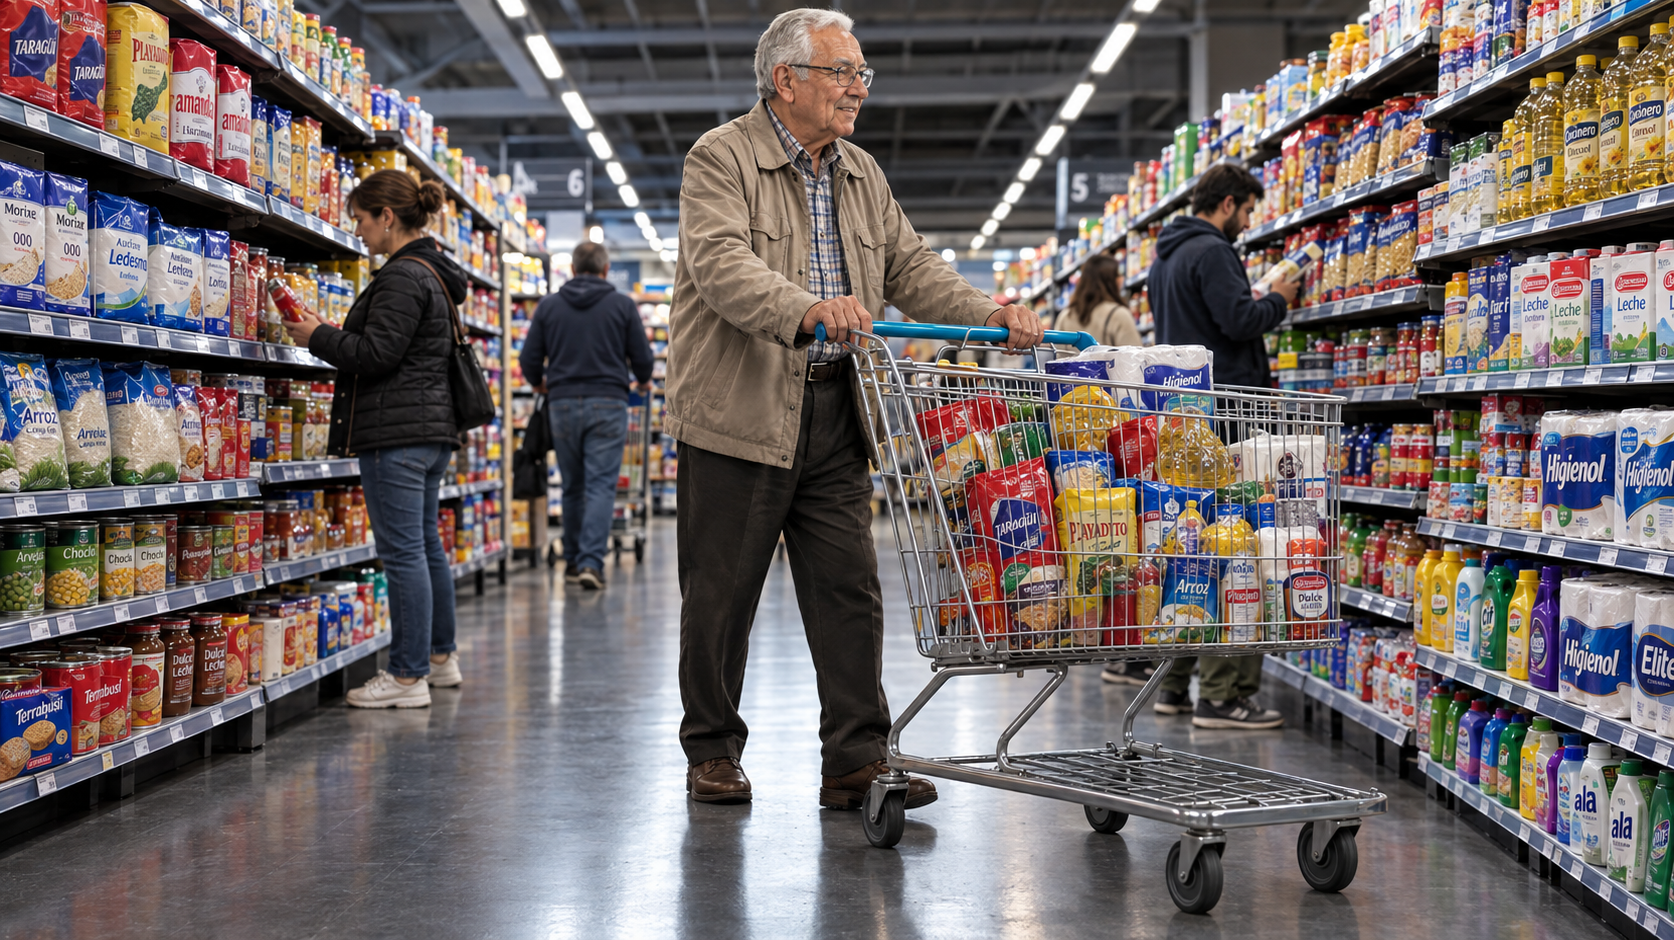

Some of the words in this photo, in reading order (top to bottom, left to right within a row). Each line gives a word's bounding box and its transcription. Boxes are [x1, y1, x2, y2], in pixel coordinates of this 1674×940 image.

[15, 37, 57, 55] TARAGÜI
[567, 168, 585, 197] 6
[1070, 172, 1089, 203] 5
[13, 232, 32, 247] 000
[63, 242, 81, 257] 000
[1523, 296, 1549, 312] Leche
[1554, 304, 1581, 318] Leche
[1617, 295, 1646, 312] Leche
[23, 407, 58, 425] Arroz
[1546, 453, 1605, 490] Higienol
[1625, 459, 1674, 494] Higienol
[1564, 638, 1619, 676] Higienol
[1641, 644, 1674, 680] Elite
[1575, 785, 1597, 813] ala
[1611, 811, 1633, 840] ala
